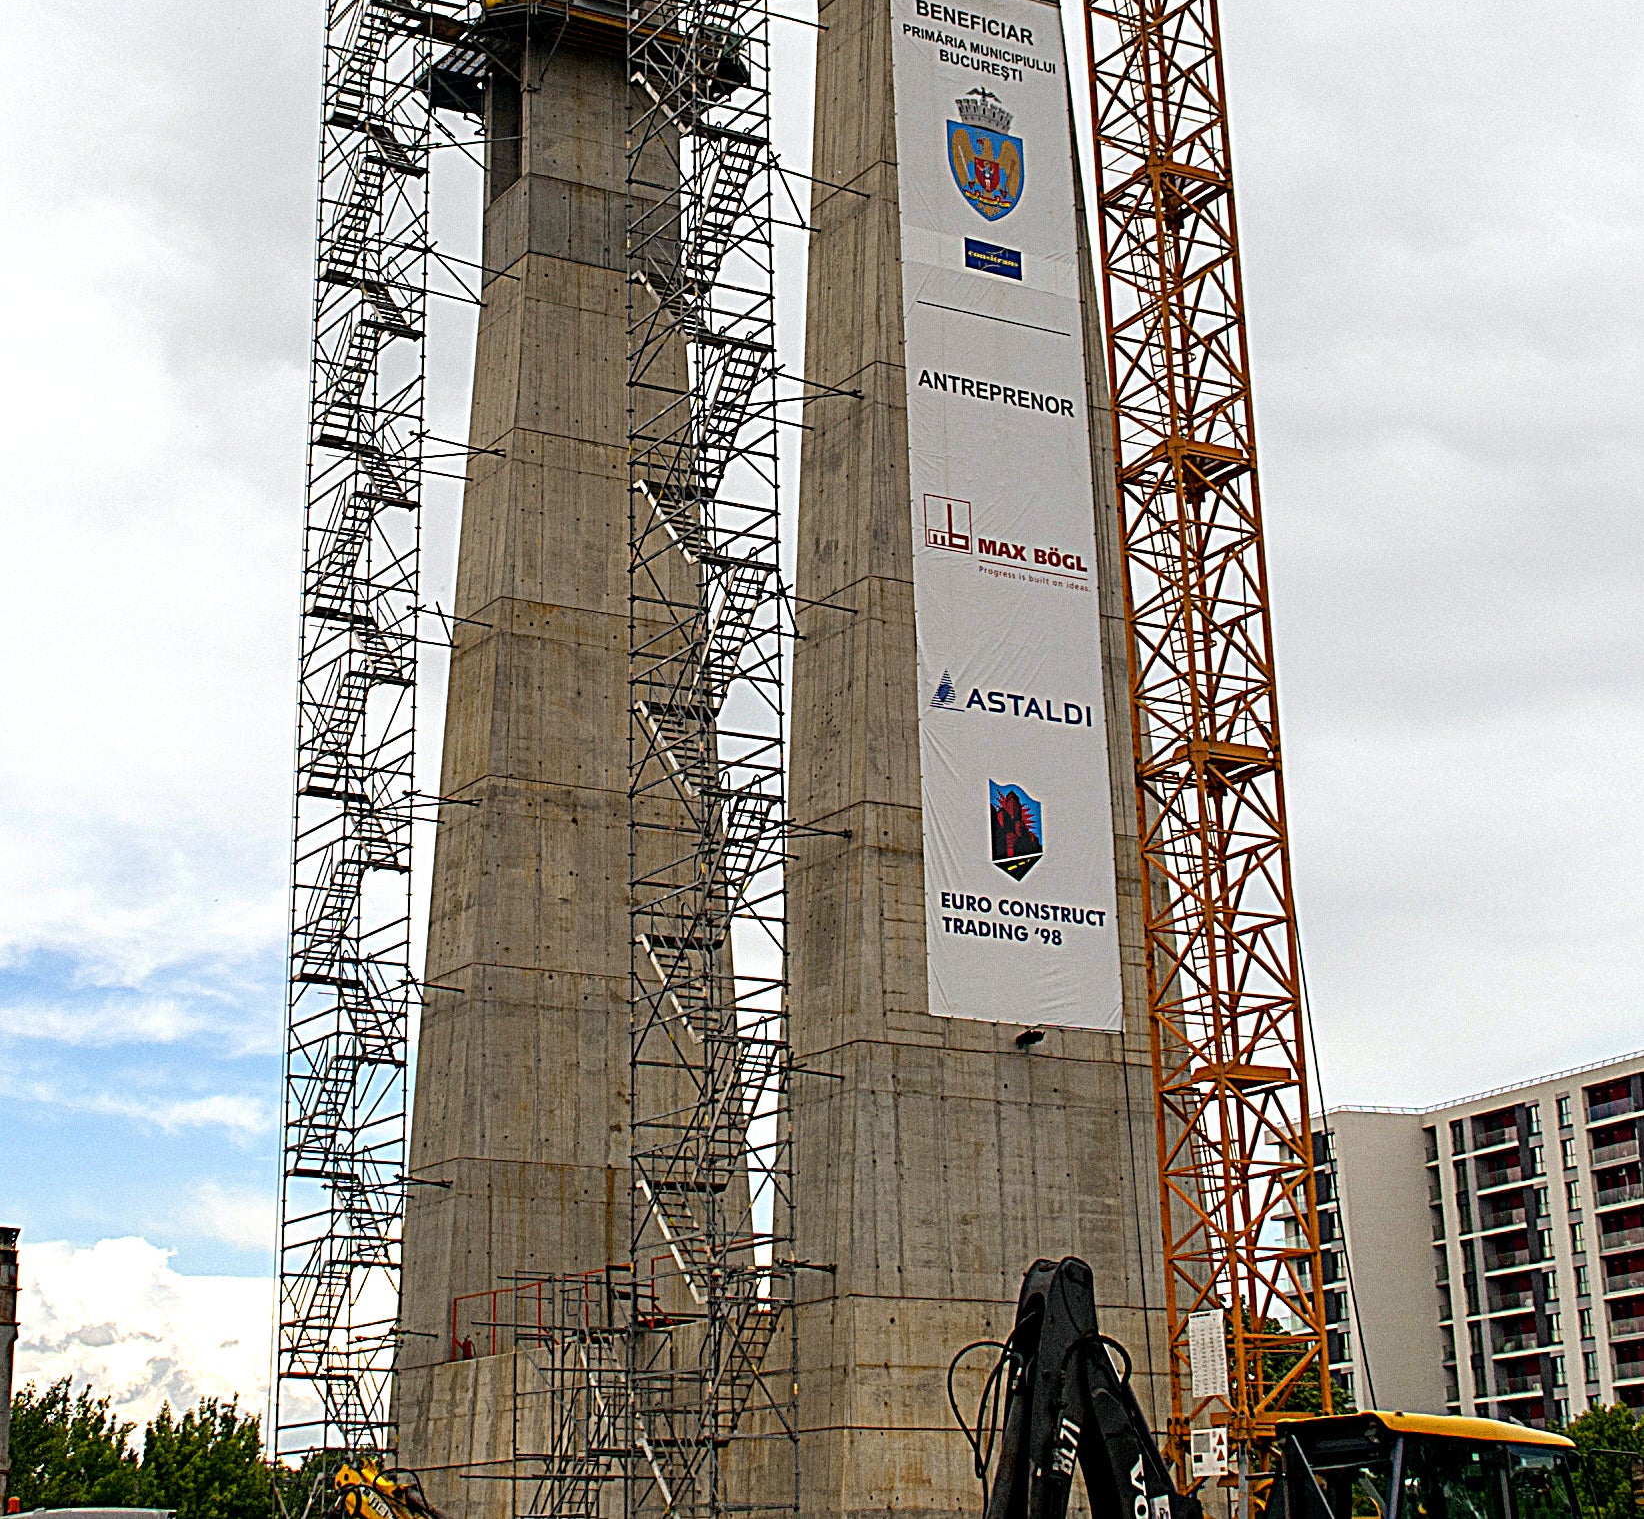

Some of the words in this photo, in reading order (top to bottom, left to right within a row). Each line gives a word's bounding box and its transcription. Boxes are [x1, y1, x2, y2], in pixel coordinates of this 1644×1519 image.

[902, 22, 967, 52] PRIMĂRIA
[969, 41, 1056, 75] MUNICIPIULUI
[918, 369, 1075, 418] ANTREPRENOR
[977, 537, 1028, 562] MAX
[1033, 546, 1088, 573] BÖGL
[978, 565, 1016, 580] Progress
[1018, 572, 1026, 582] is
[1028, 574, 1050, 586] built
[1052, 580, 1064, 588] on
[966, 688, 1092, 728] ASTALDI
[940, 891, 992, 913] EURO
[998, 899, 1106, 927] CONSTRUCT
[941, 916, 1029, 942] TRADING
